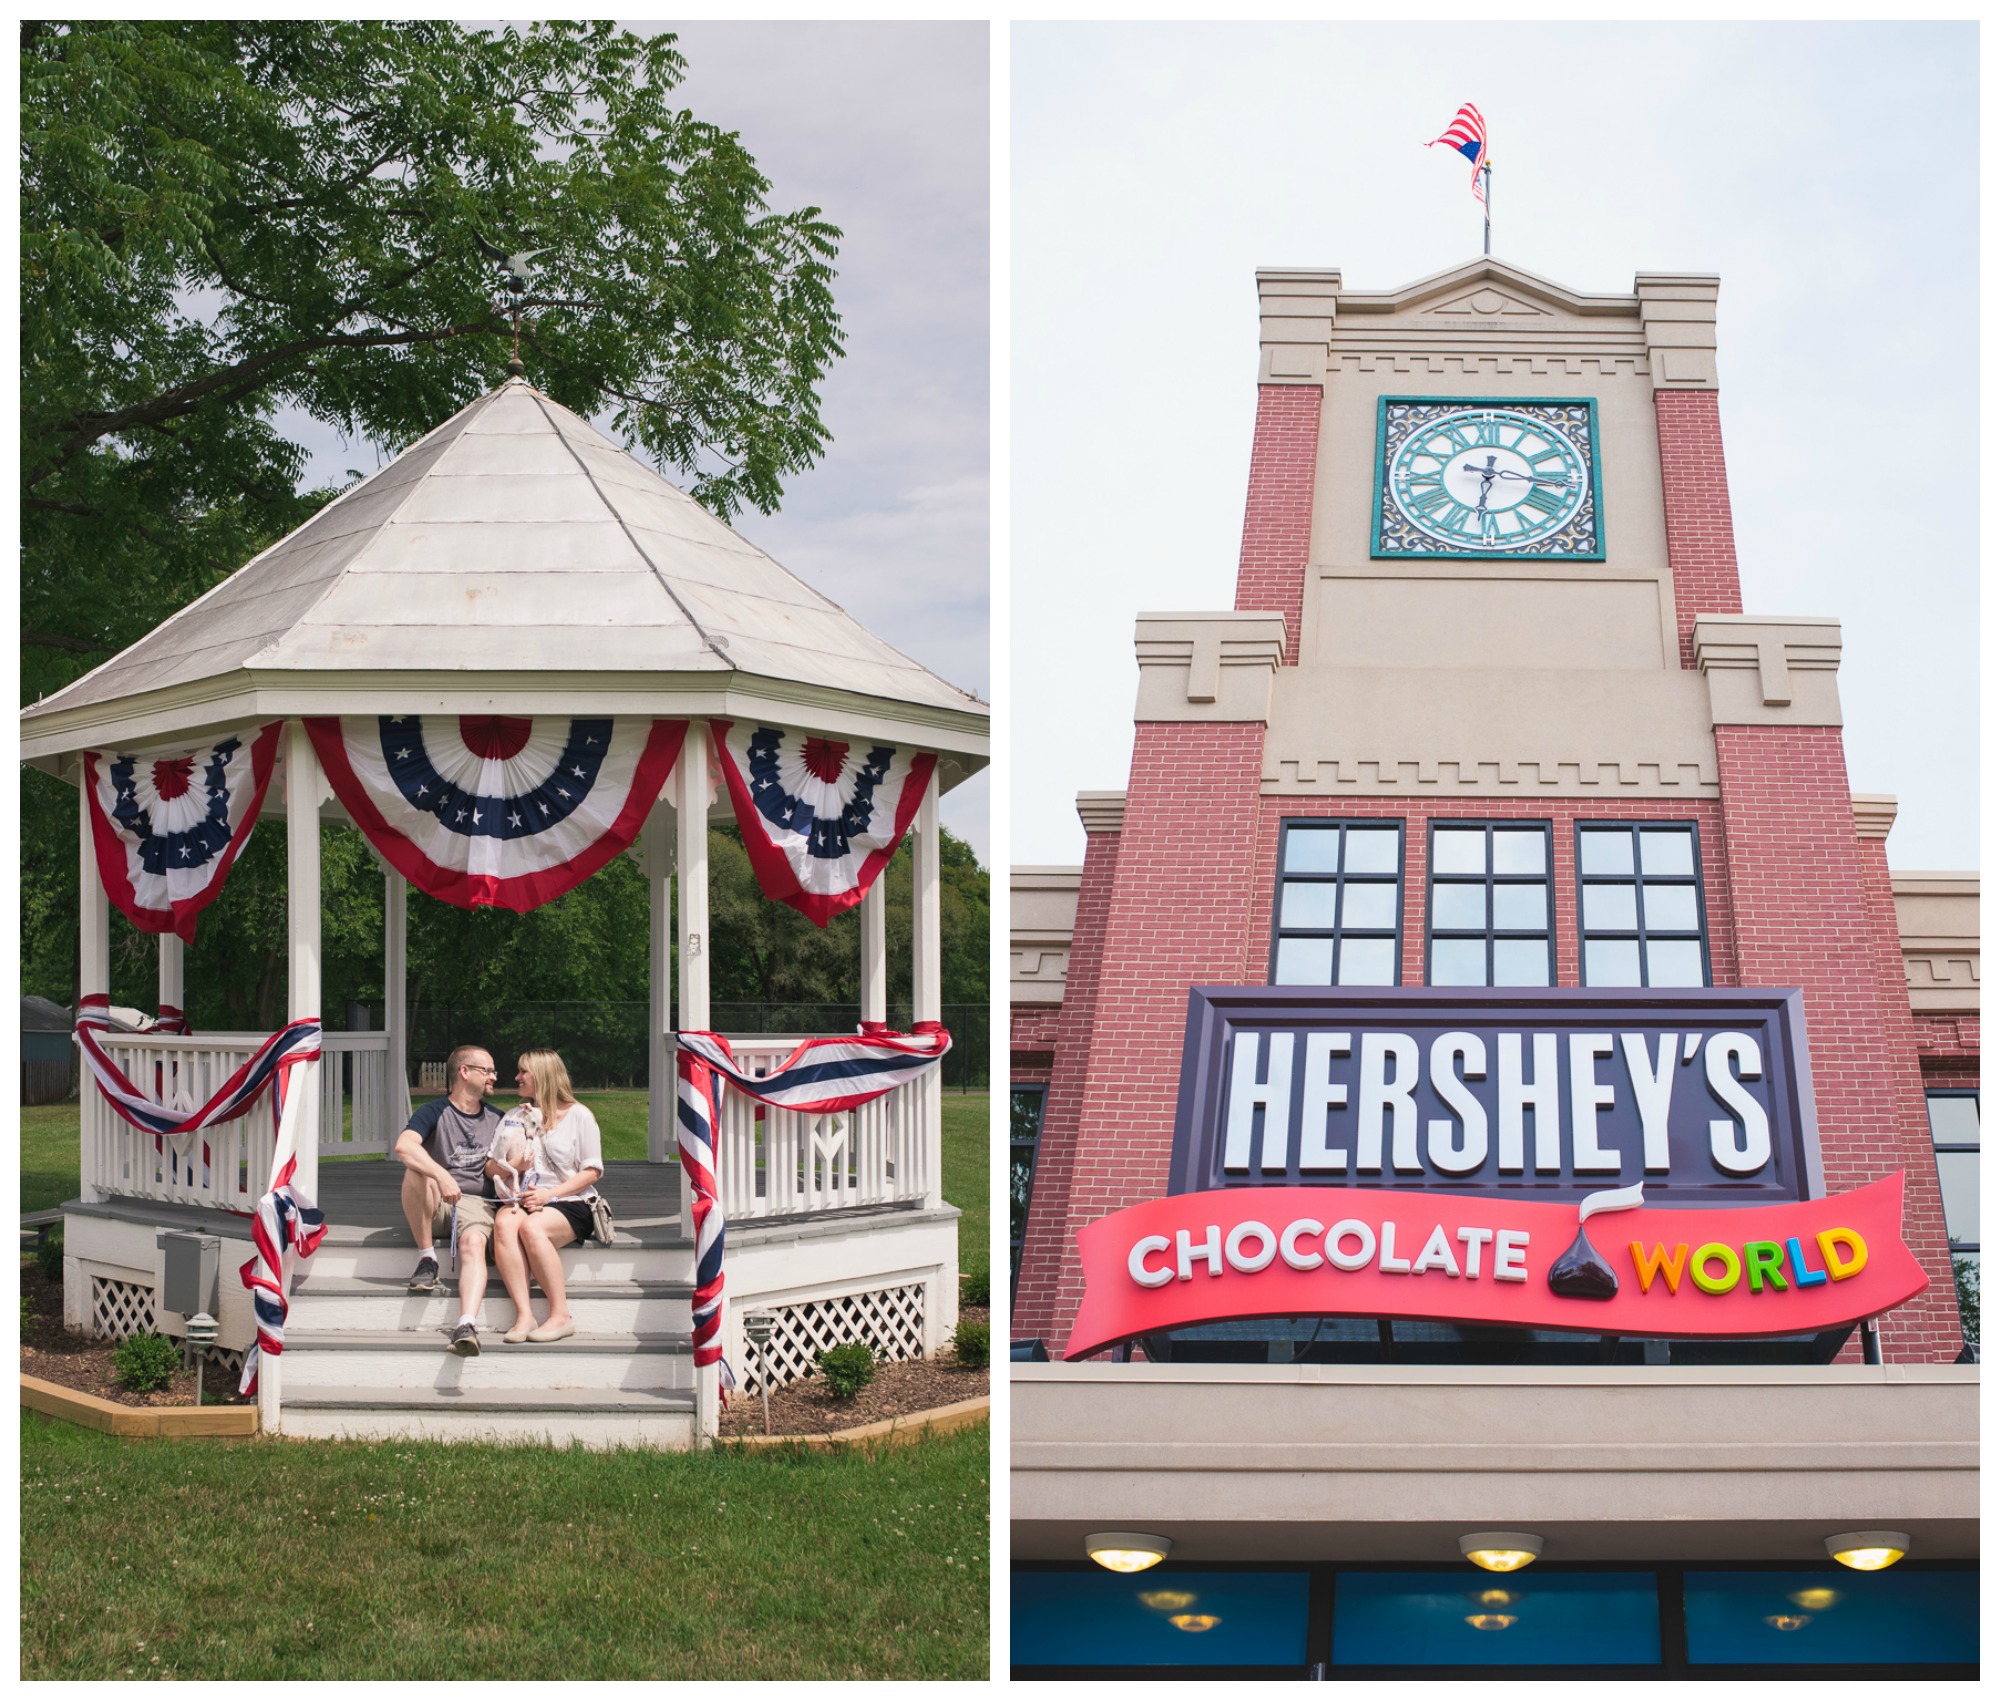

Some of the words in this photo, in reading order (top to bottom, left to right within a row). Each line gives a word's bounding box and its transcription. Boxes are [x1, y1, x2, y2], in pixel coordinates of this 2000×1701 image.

[1223, 1031, 1772, 1177] HERSHEY'S
[1128, 1218, 1530, 1288] CHOCOLATE
[1628, 1227, 1868, 1295] WORLD
